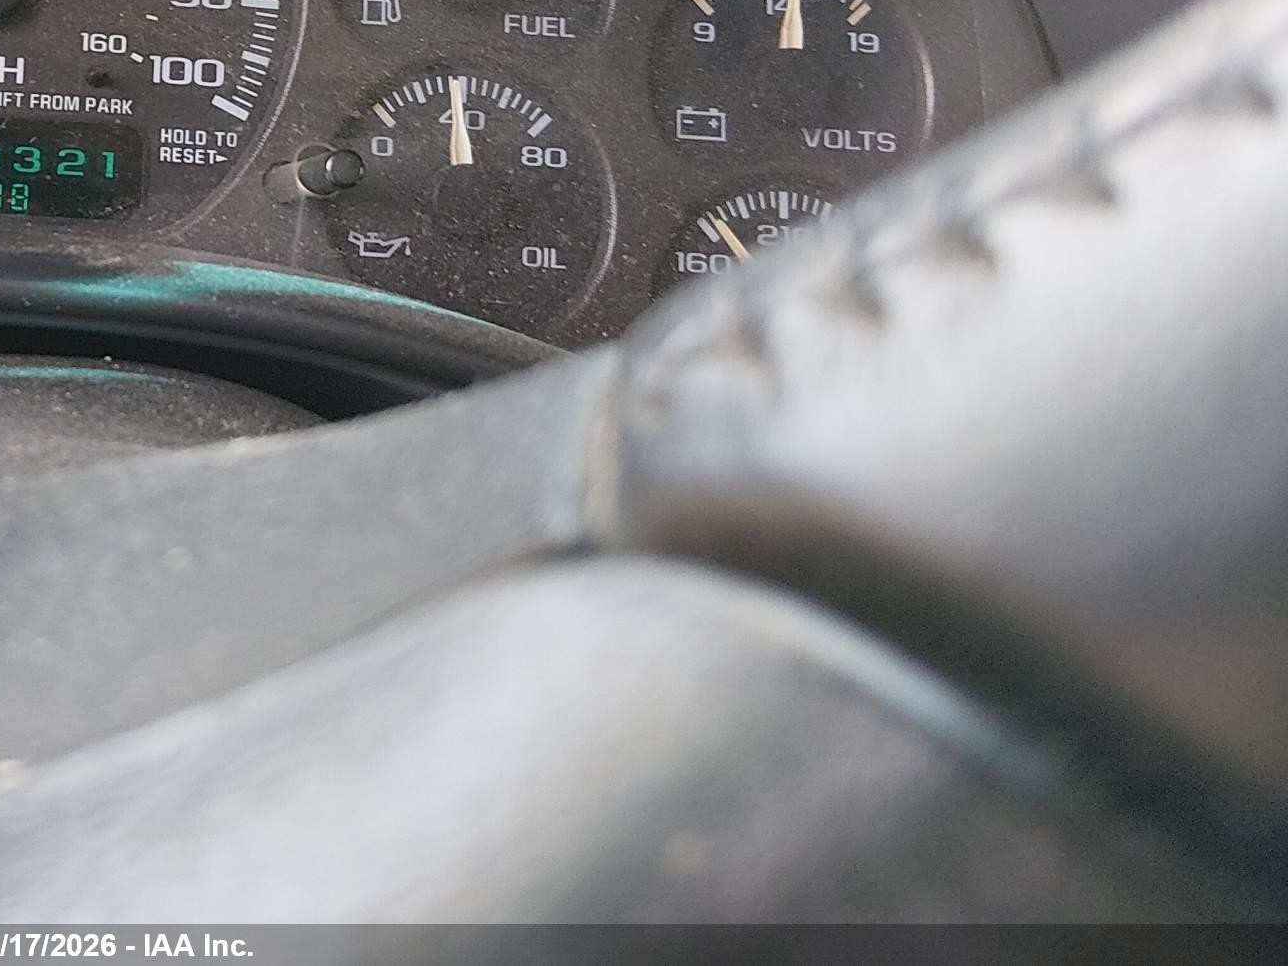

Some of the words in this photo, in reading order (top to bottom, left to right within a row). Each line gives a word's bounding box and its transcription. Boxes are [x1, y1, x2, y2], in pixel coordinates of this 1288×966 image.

[504, 15, 575, 37] FUEL
[694, 21, 715, 42] 9
[81, 33, 127, 54] 160
[847, 32, 879, 53] 19
[152, 56, 225, 87] 100
[30, 94, 80, 111] FROM
[85, 97, 133, 115] PARK
[161, 128, 206, 146] HOLD
[214, 131, 238, 148] TO
[372, 137, 393, 157] 0
[802, 127, 896, 152] VOLTS
[13, 146, 41, 173] 3
[57, 149, 86, 176] 2
[103, 151, 115, 178] 1
[160, 147, 214, 164] RESET
[521, 146, 566, 168] 80
[522, 246, 565, 268] OIL
[675, 251, 731, 275] 160
